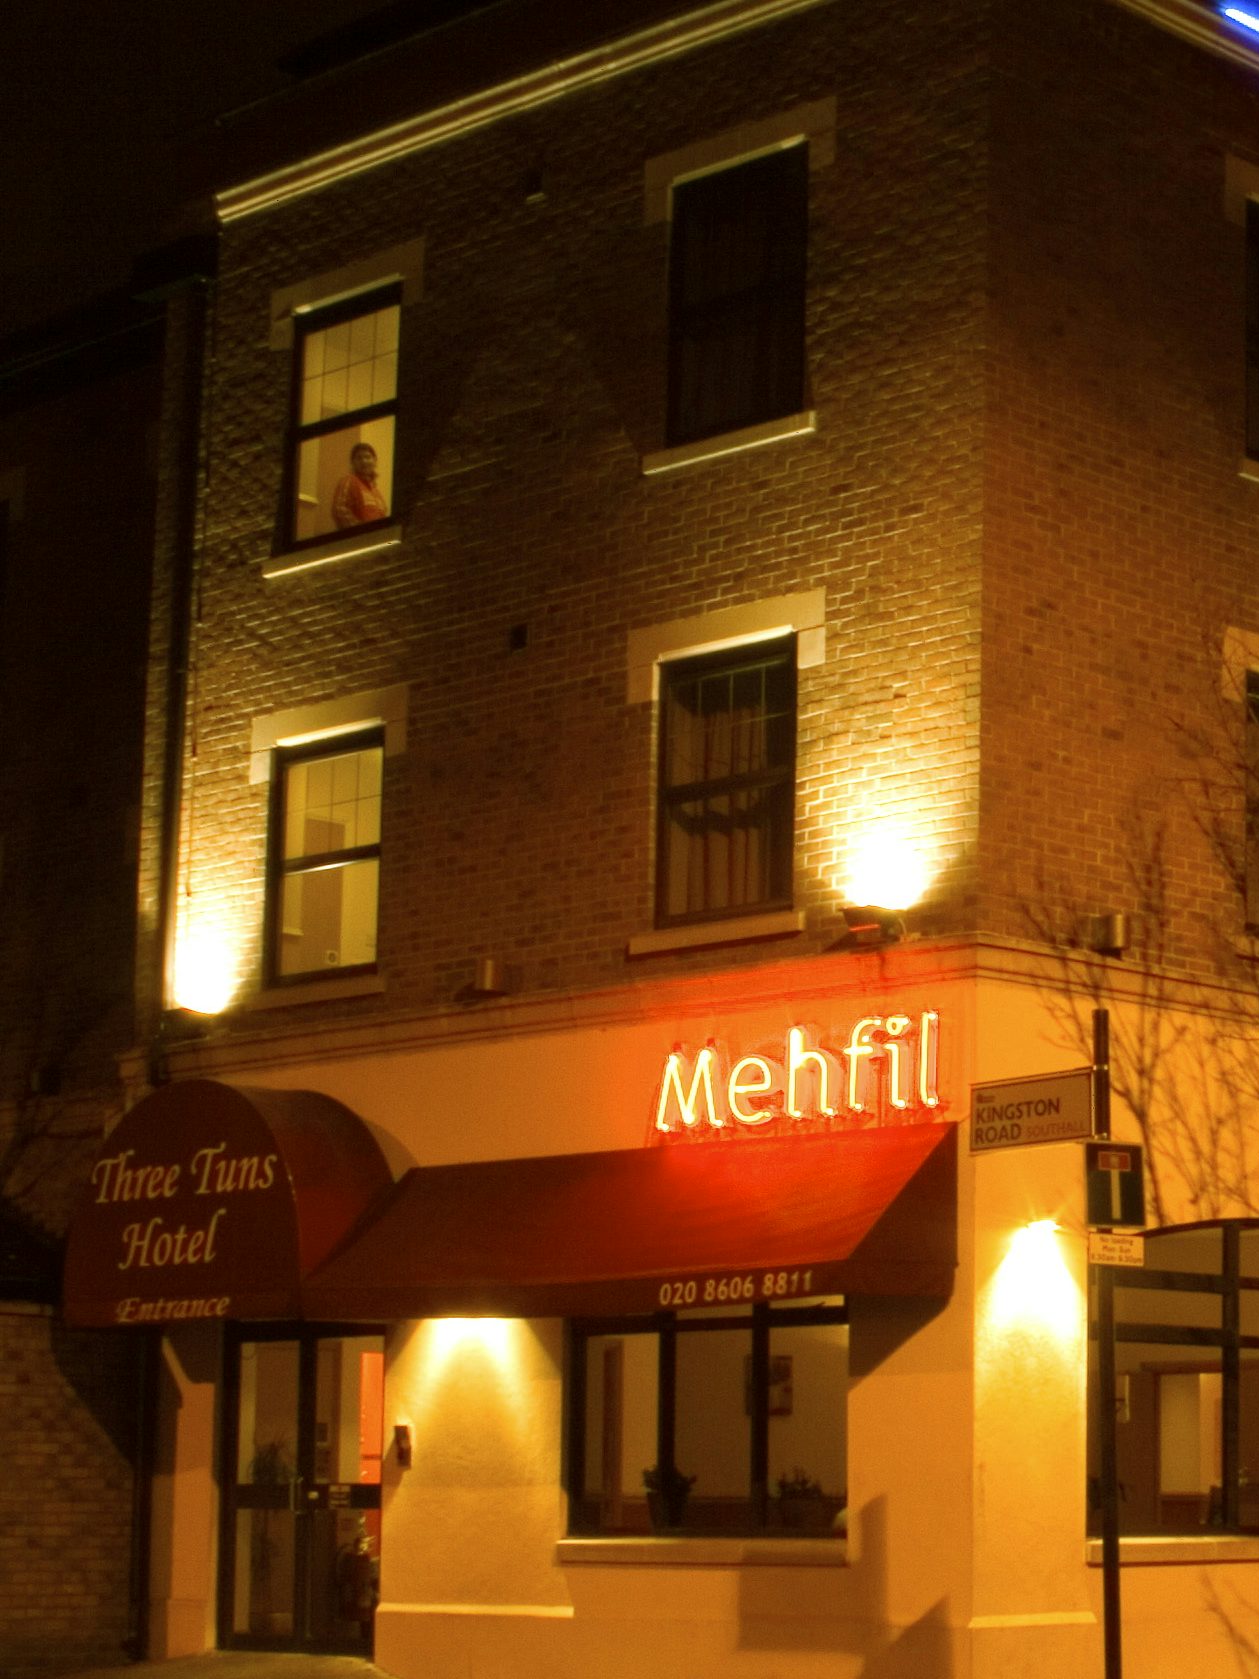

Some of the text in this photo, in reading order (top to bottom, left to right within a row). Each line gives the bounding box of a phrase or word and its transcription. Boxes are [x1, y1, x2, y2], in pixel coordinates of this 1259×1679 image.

[656, 1011, 940, 1131] Mehfil
[975, 1097, 1060, 1125] KINGSTON
[974, 1120, 1085, 1145] ROAD SOUTHALL
[92, 1142, 278, 1204] Three Tuns
[117, 1209, 227, 1270] Hotel
[659, 1269, 813, 1306] 020 8606 8811
[116, 1296, 231, 1323] Entrance
